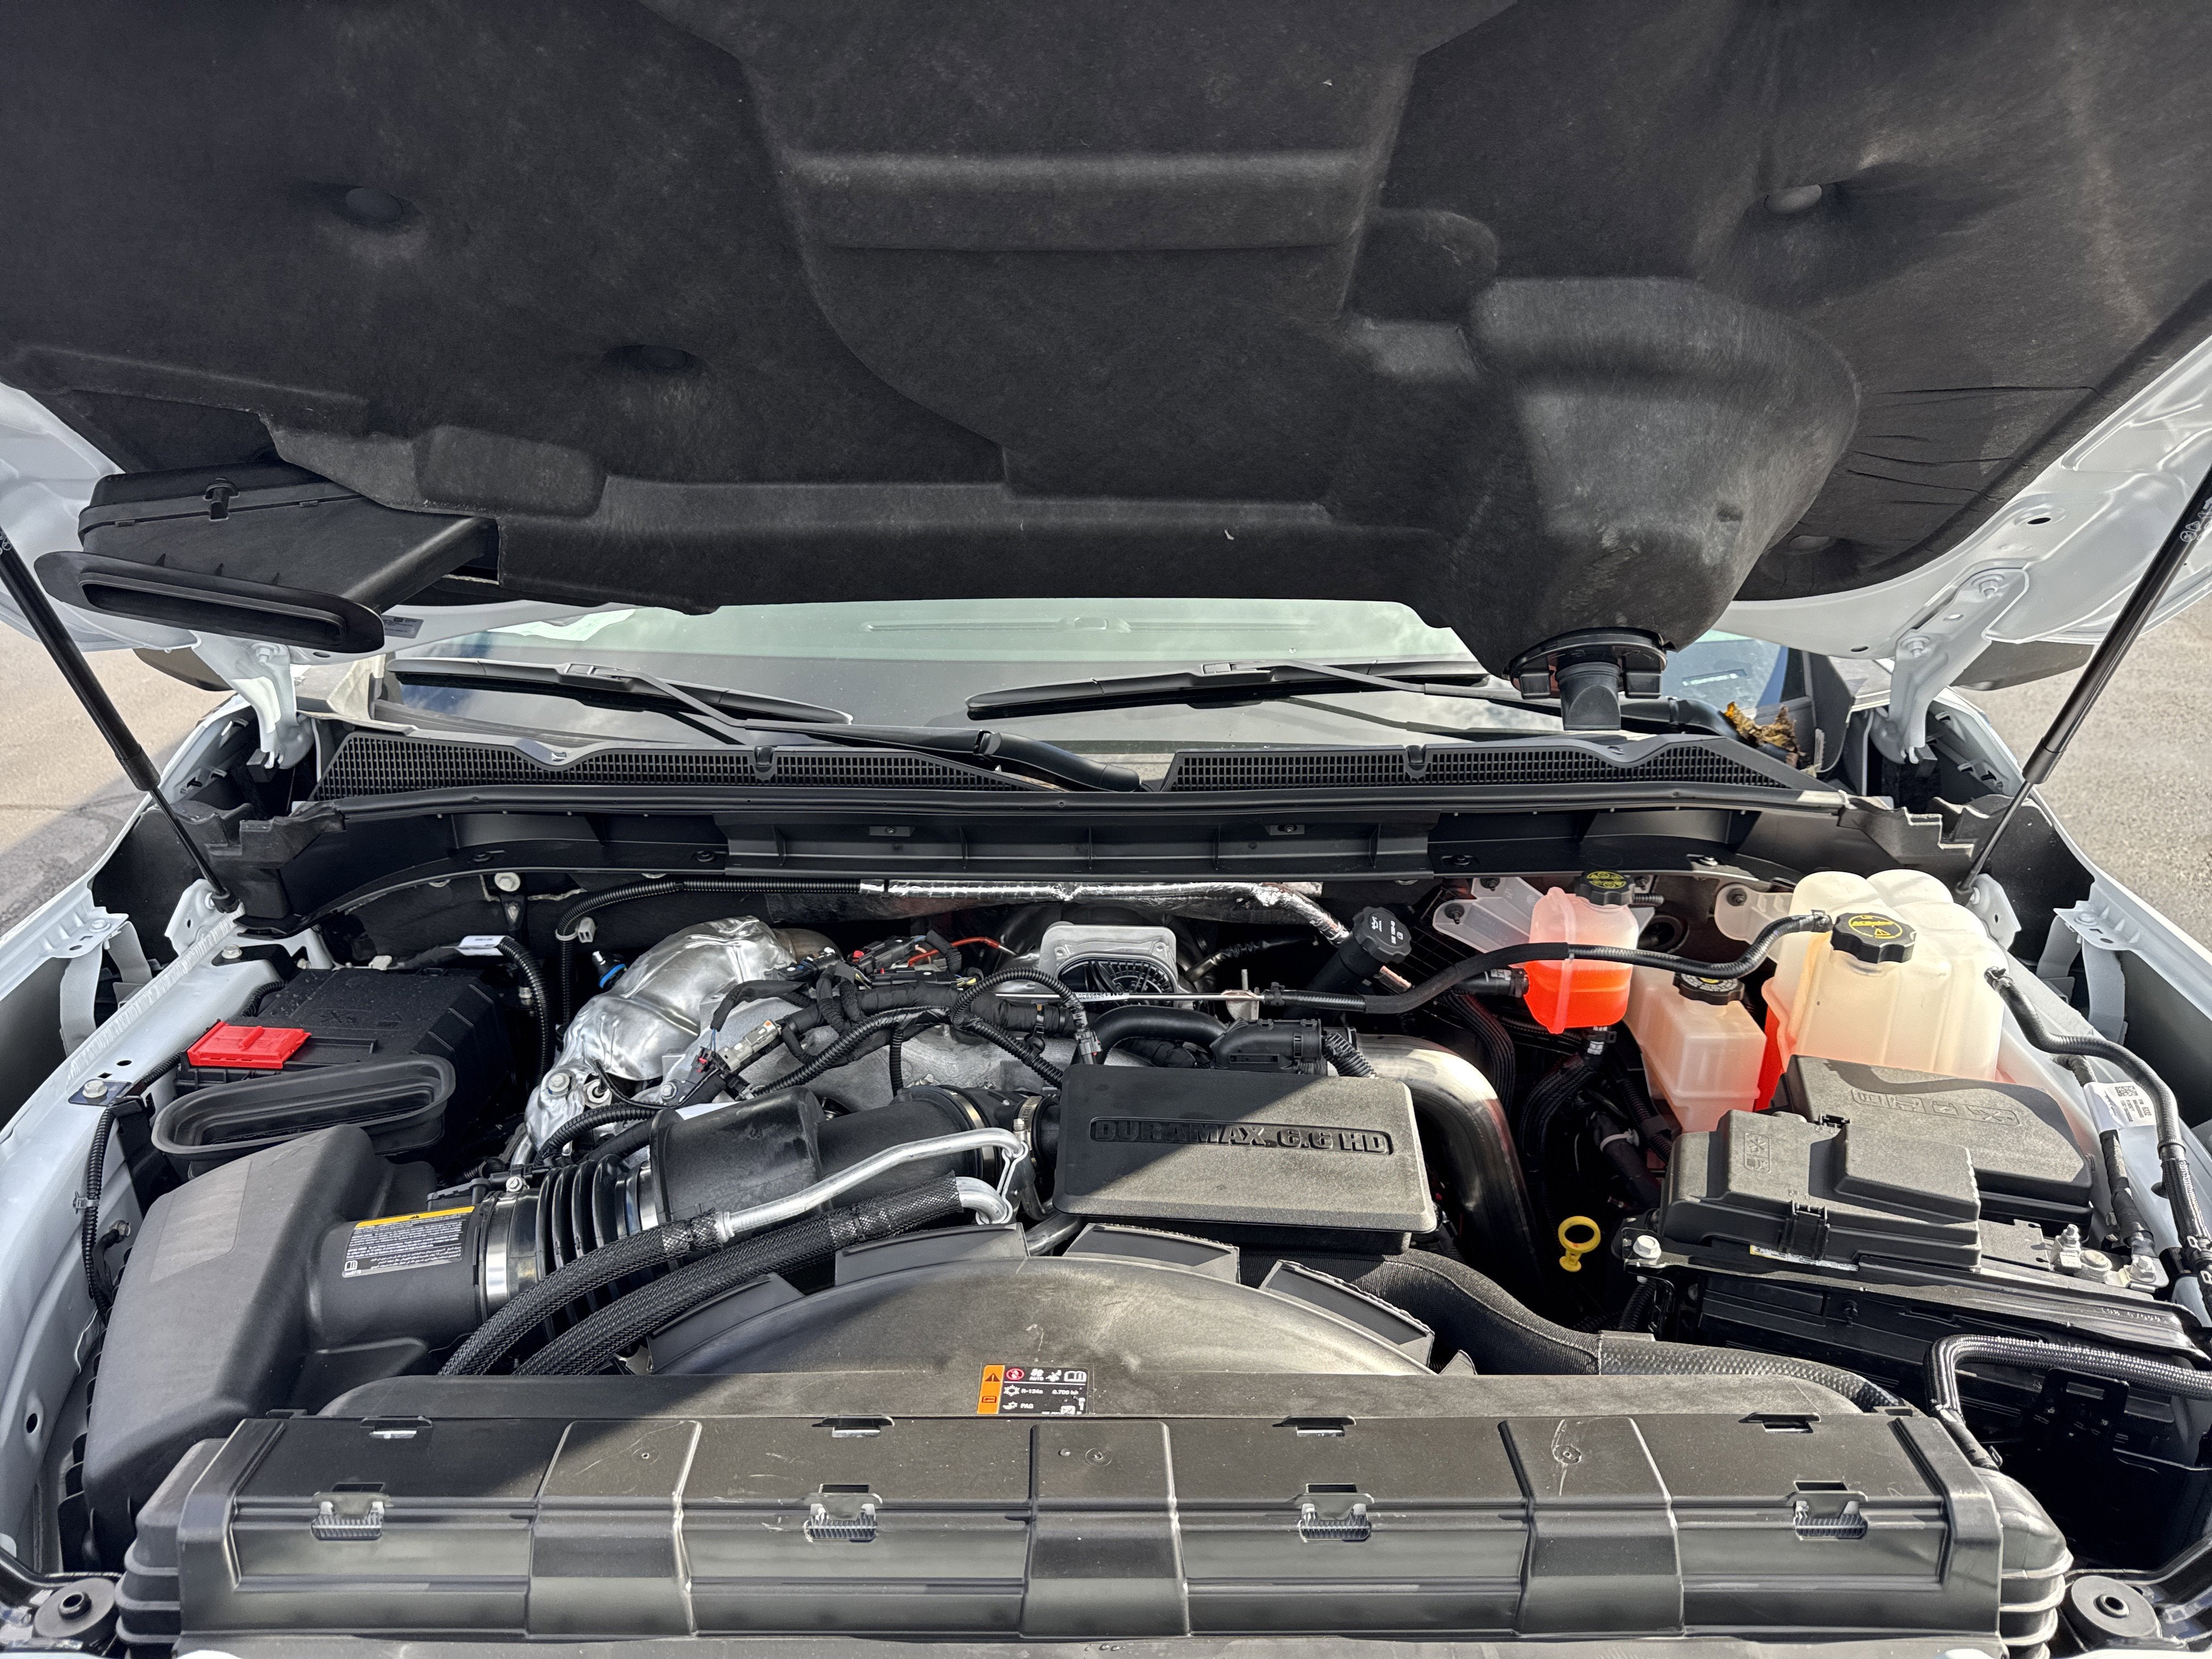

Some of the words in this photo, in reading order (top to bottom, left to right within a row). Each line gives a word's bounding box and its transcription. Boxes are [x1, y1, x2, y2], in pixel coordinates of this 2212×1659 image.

[1095, 1121, 1267, 1147] DURAMAX
[1277, 1127, 1334, 1149] 6.6
[1339, 1132, 1389, 1153] HD
